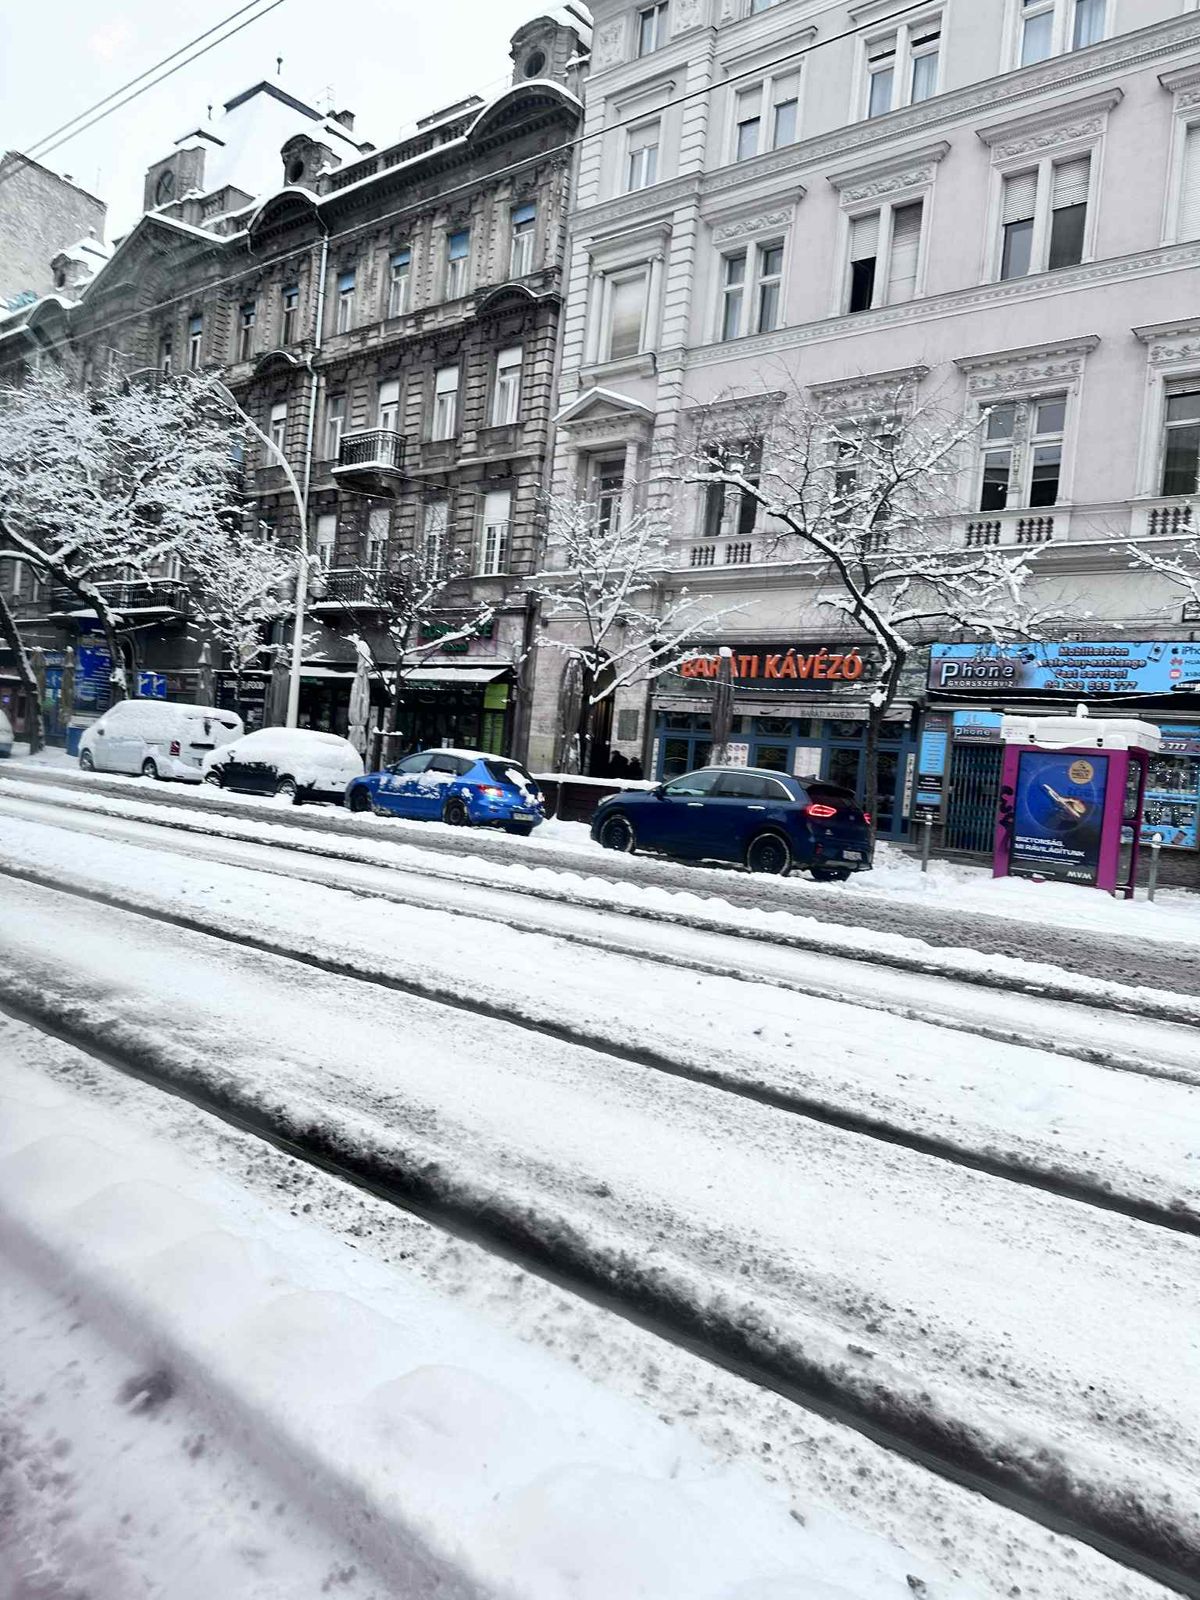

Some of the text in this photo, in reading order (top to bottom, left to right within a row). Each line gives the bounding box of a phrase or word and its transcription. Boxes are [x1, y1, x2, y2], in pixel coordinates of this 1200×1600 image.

[764, 647, 863, 679] KÁVÉZÓ
[940, 661, 1014, 687] Phone
[954, 727, 991, 739] Phone
[1066, 870, 1093, 880] MVM
